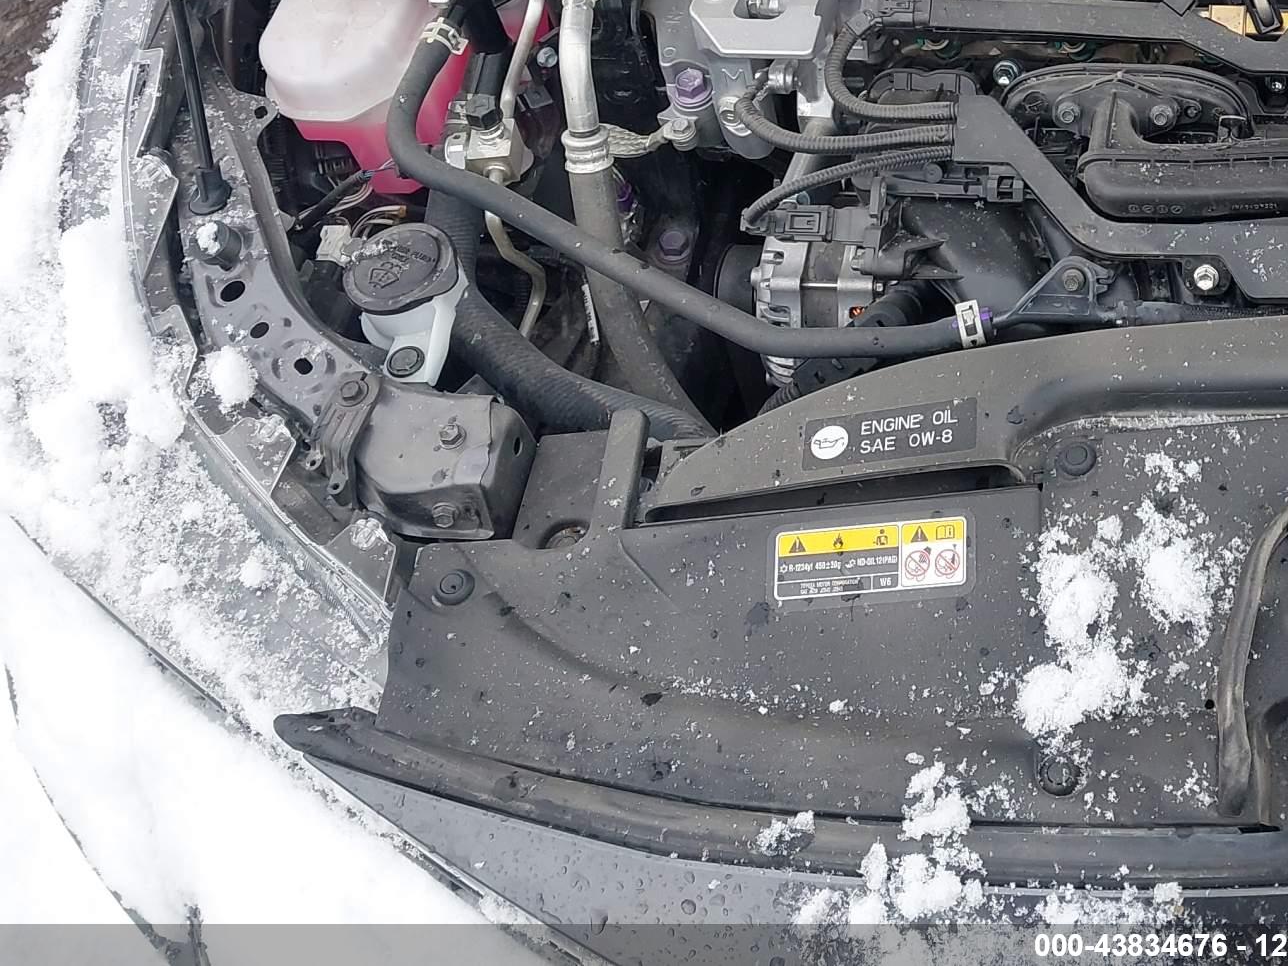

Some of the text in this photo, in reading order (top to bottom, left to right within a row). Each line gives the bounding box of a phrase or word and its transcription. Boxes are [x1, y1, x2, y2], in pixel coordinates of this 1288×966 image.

[861, 409, 957, 436] ENGINE OIL
[860, 429, 953, 454] SAE 0W-8
